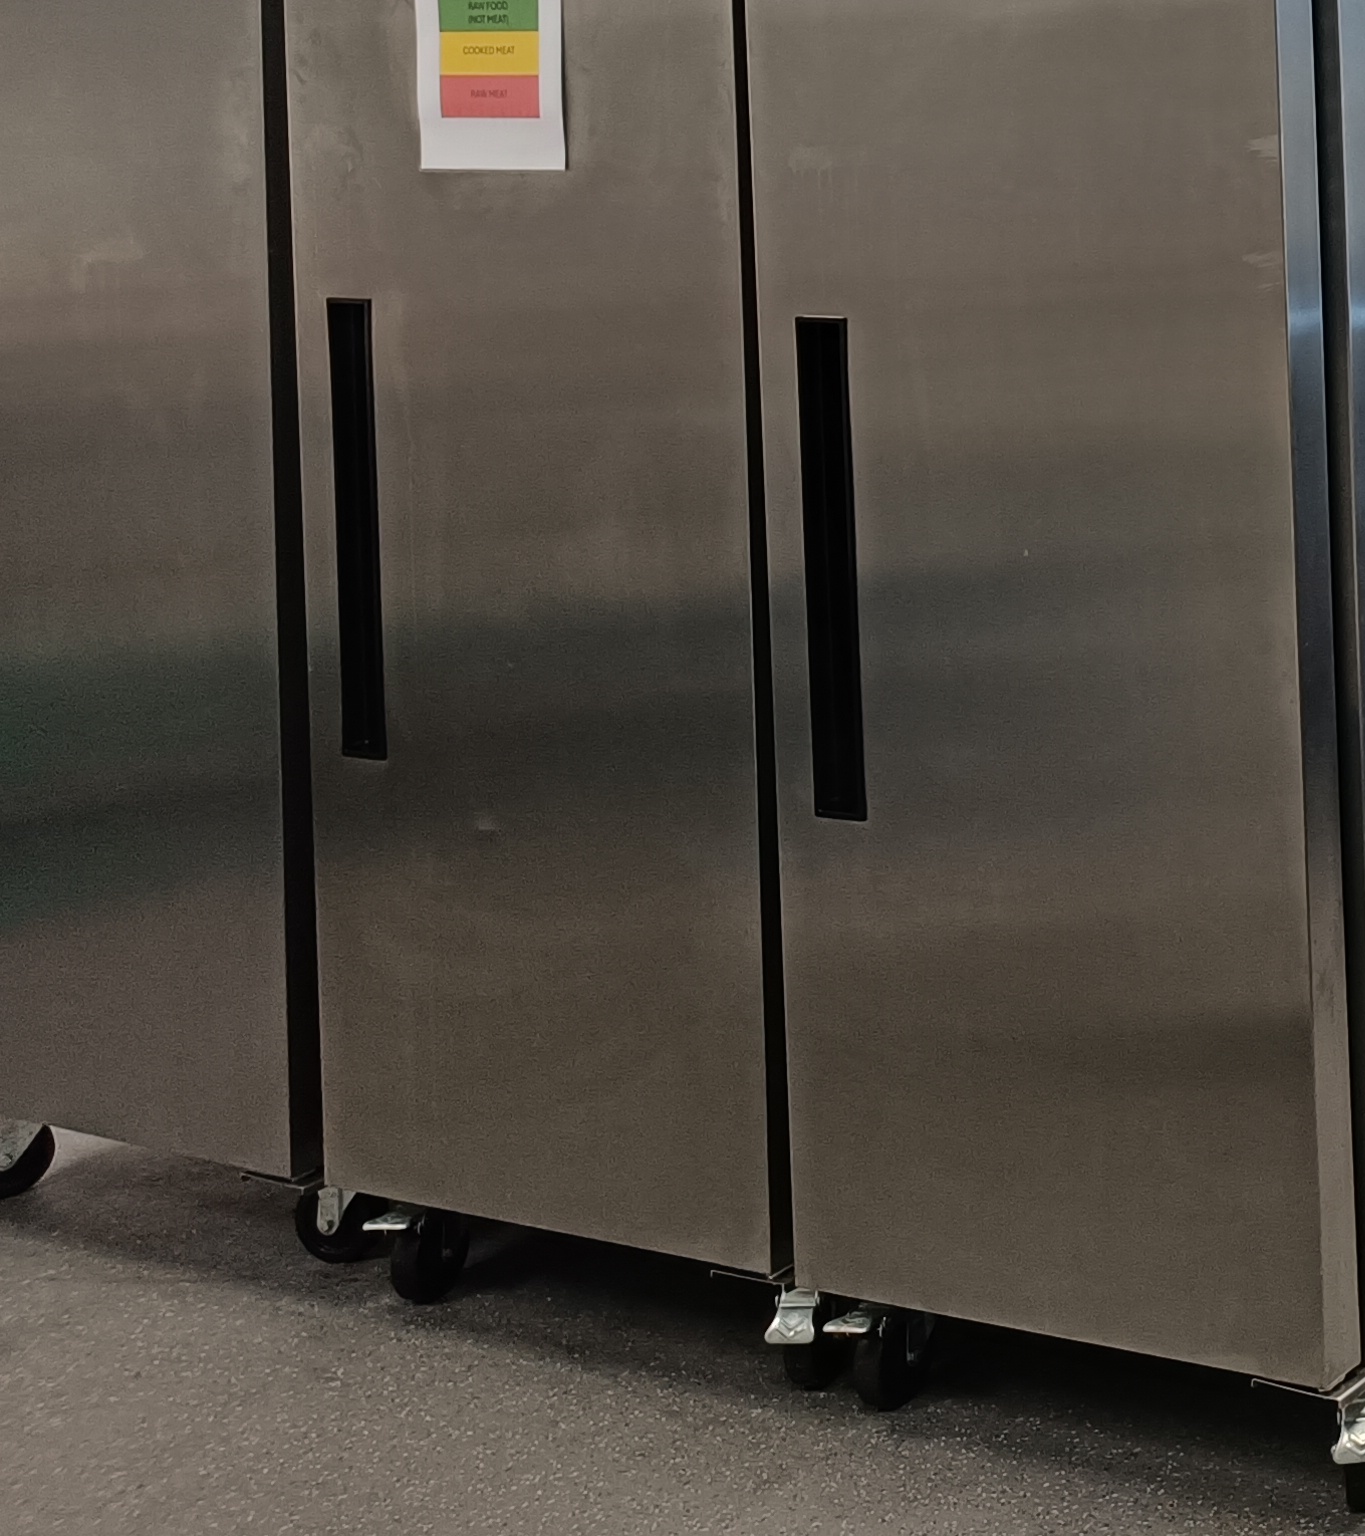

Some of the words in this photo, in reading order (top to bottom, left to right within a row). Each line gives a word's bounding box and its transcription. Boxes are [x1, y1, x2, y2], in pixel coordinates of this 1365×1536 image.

[468, 2, 485, 10] RAW
[486, 1, 509, 10] FOOD
[463, 46, 495, 55] COOKED
[496, 46, 515, 55] MEAT
[470, 89, 487, 98] RAW
[488, 89, 508, 98] MEAT
